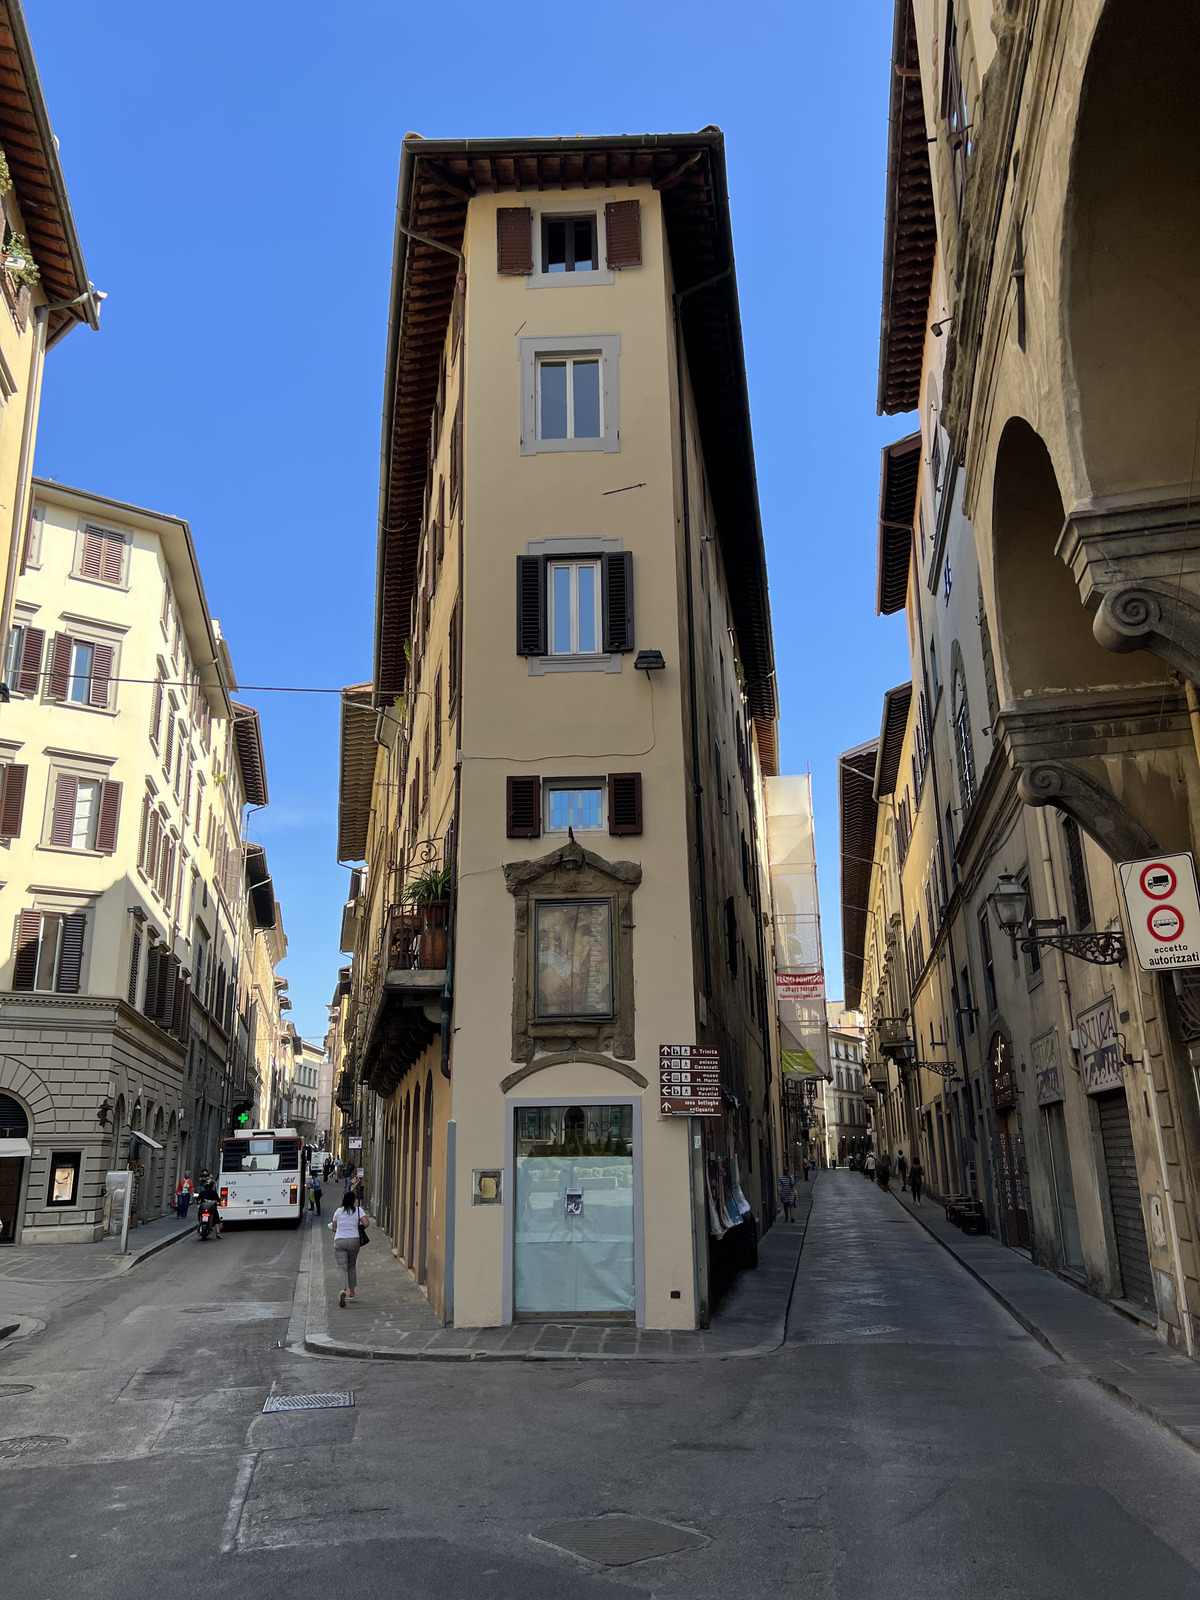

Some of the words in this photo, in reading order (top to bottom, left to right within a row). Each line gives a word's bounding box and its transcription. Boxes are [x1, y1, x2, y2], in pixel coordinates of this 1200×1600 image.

[1149, 952, 1199, 965] autorizzati
[1154, 944, 1188, 953] eccetto
[1080, 1011, 1115, 1049] OTTICA
[999, 1133, 1010, 1175] BOTTEGA
